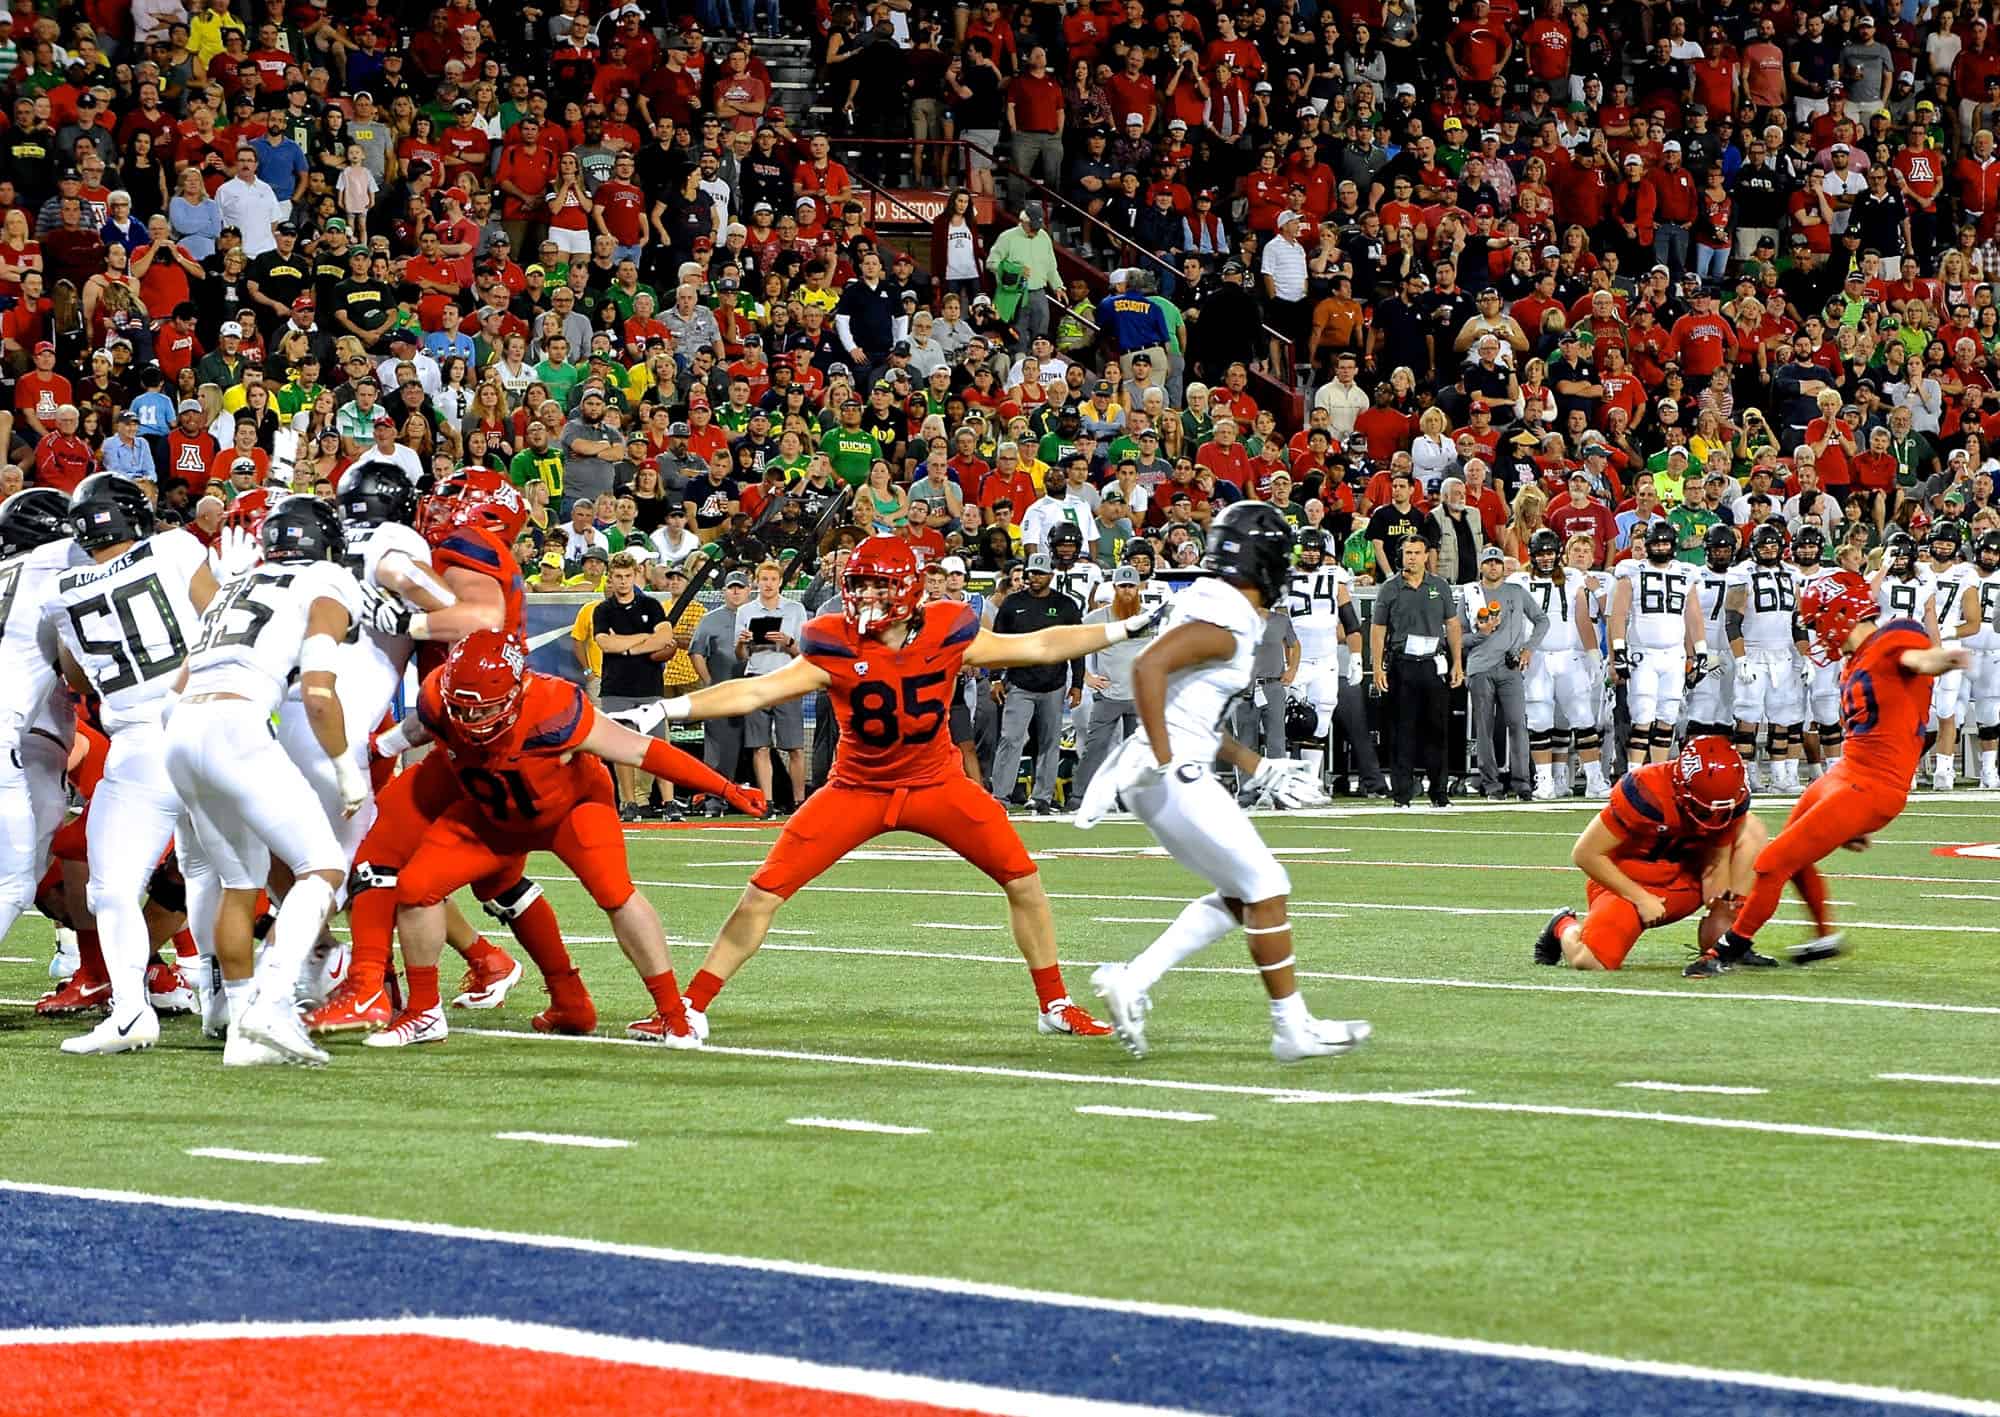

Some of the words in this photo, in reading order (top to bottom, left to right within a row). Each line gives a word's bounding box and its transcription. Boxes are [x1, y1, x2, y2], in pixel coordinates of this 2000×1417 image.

[1908, 156, 1935, 182] A
[891, 201, 945, 220] SECTION
[1127, 207, 1138, 229] 7
[1113, 299, 1151, 315] SECURITY
[139, 404, 158, 425] 11
[175, 443, 206, 473] A
[839, 440, 872, 451] DUCKS
[1287, 574, 1336, 619] 54
[1529, 582, 1569, 622] 71
[1640, 571, 1687, 614] 66
[1890, 585, 1917, 621] 9
[67, 572, 189, 697] 50
[849, 669, 948, 749] 85
[460, 768, 542, 822] 91
